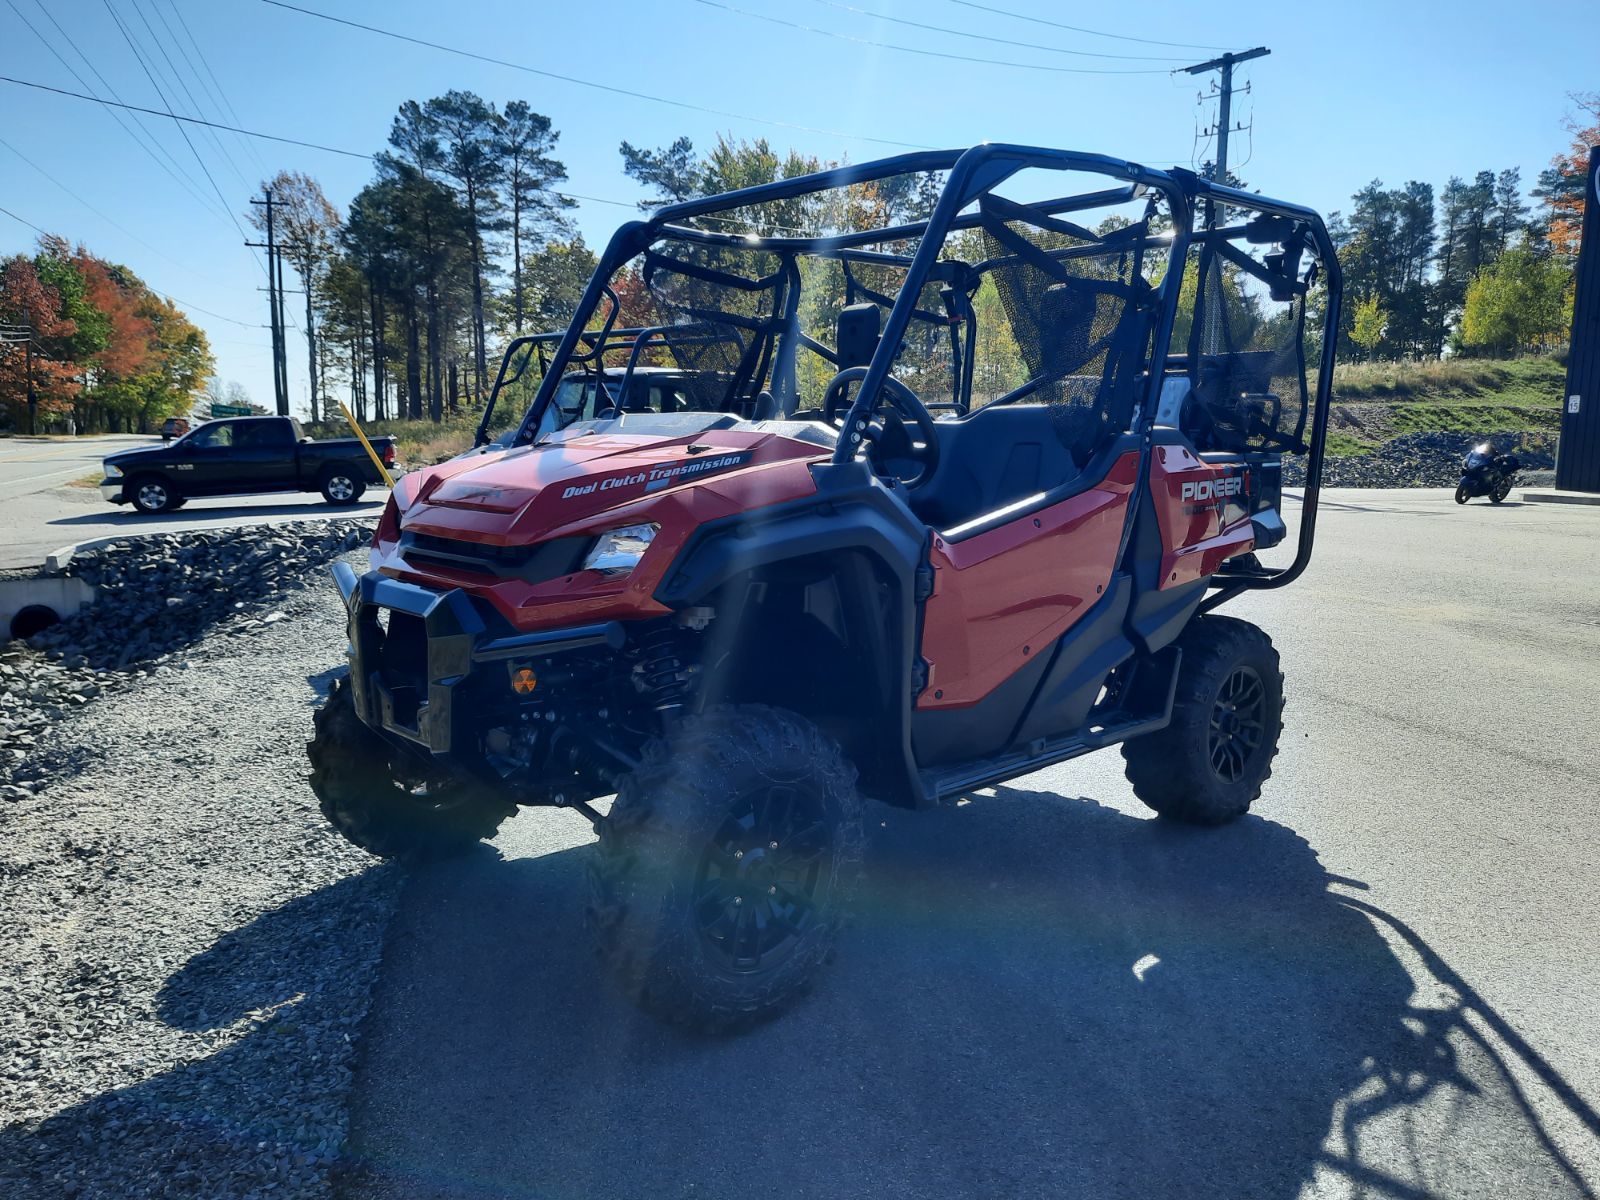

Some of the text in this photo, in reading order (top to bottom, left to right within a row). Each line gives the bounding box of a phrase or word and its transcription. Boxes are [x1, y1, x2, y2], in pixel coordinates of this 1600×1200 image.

[562, 456, 741, 499] Dual Clutch Transmission
[1181, 477, 1242, 502] PIONEER
